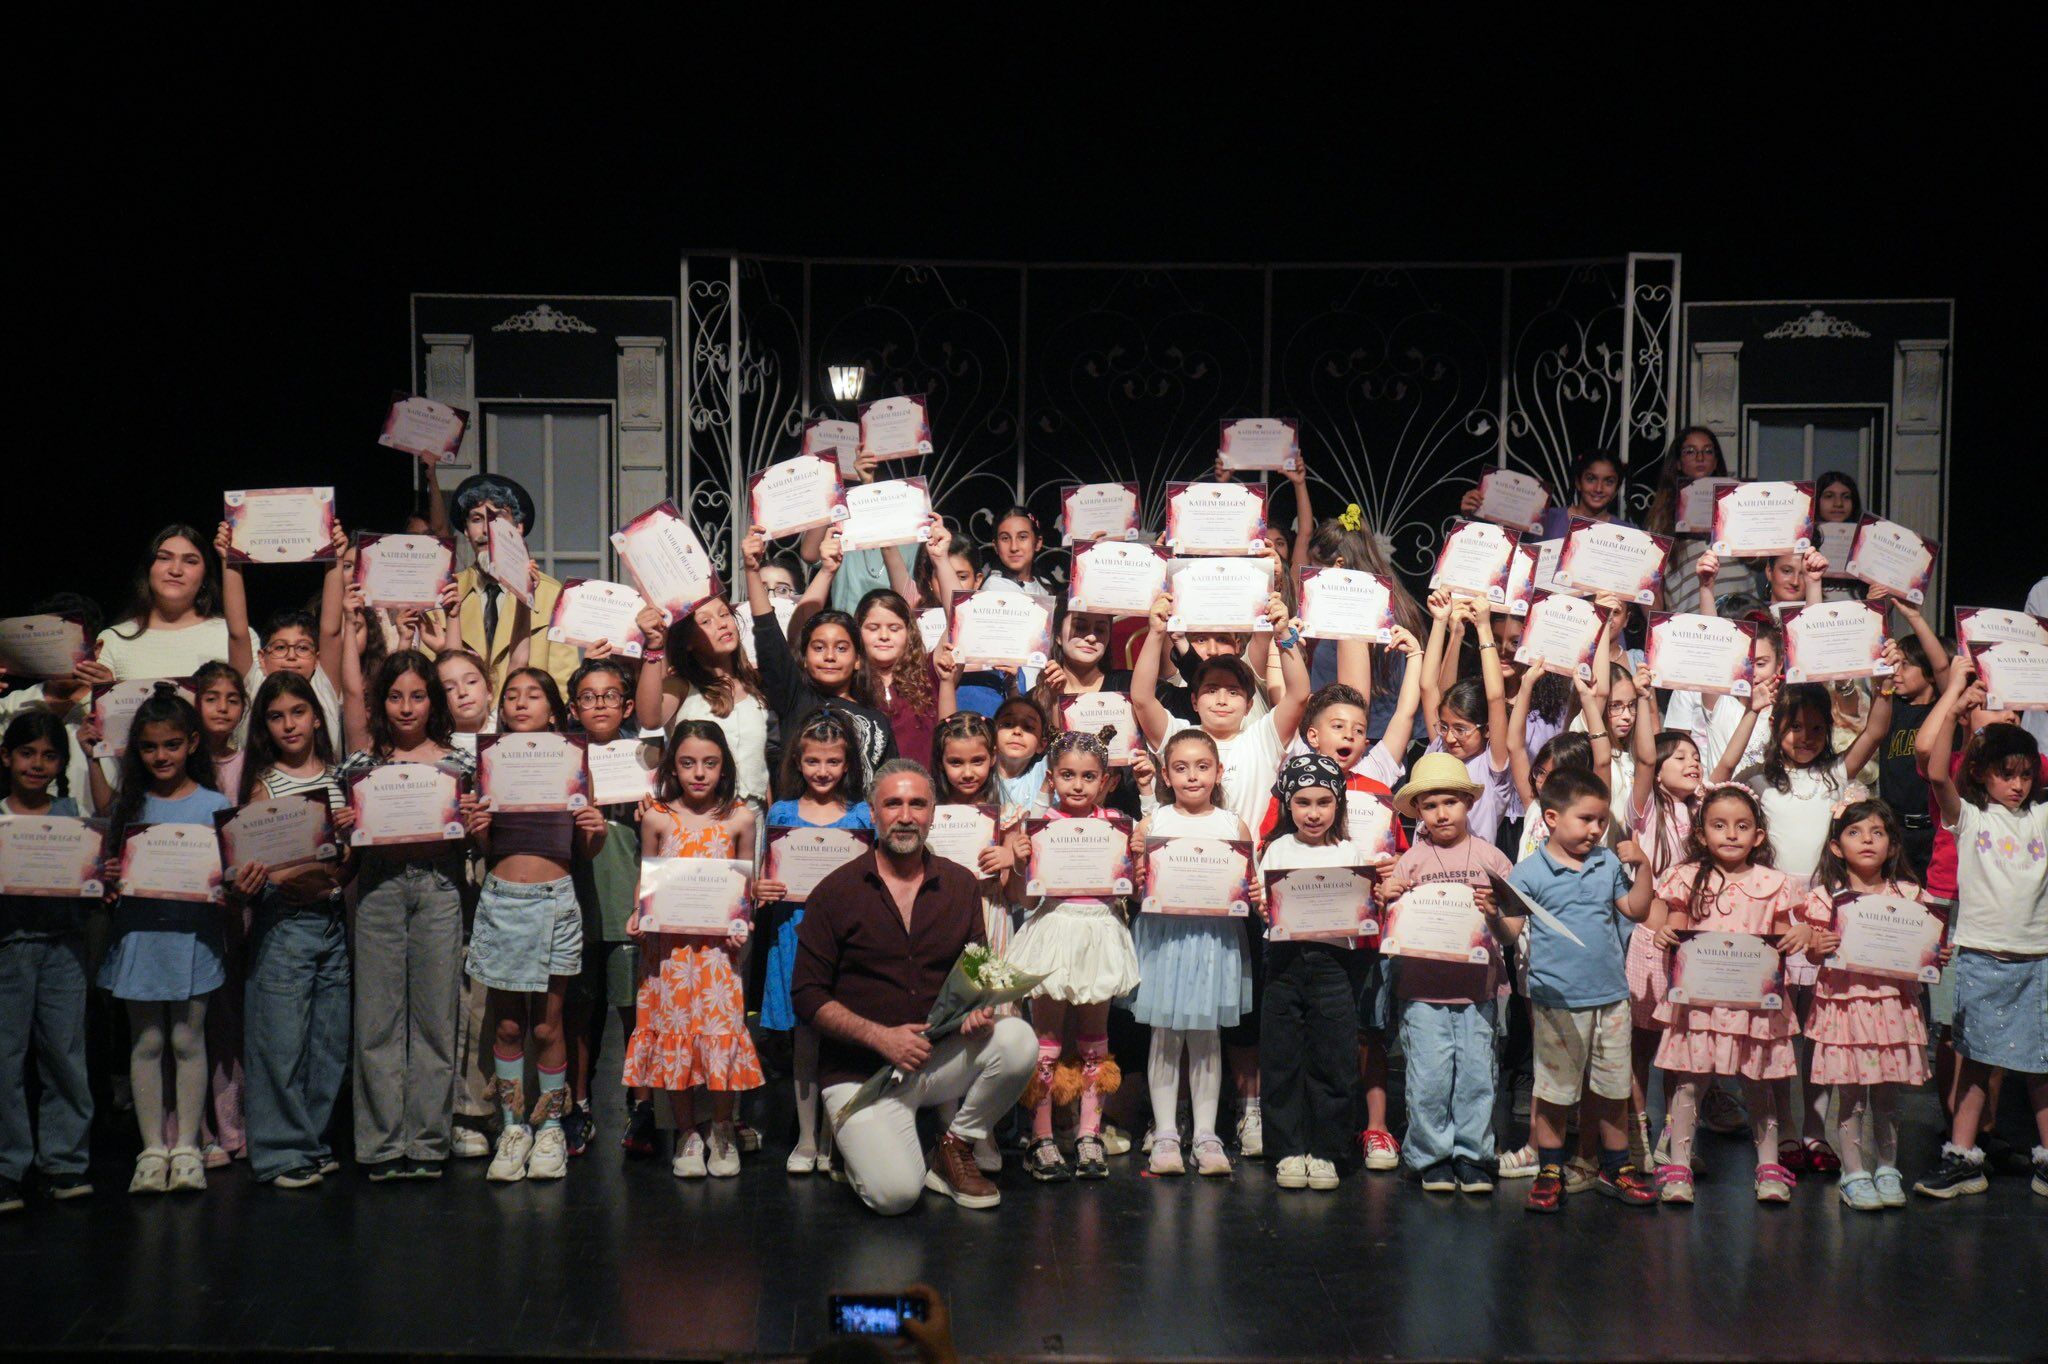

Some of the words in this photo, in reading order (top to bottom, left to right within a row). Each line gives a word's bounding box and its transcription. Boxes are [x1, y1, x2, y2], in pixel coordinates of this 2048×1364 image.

[1590, 537, 1619, 549] KATILIM
[580, 594, 607, 604] KATILIM
[1806, 620, 1835, 629] KATILIM
[1672, 631, 1701, 640] KATILIM
[374, 783, 404, 791] KATILIM
[243, 816, 274, 829] KATILIM
[1421, 870, 1468, 882] FEARLESS
[1858, 912, 1890, 922] KATILIM
[1697, 949, 1728, 957] KATILIM
